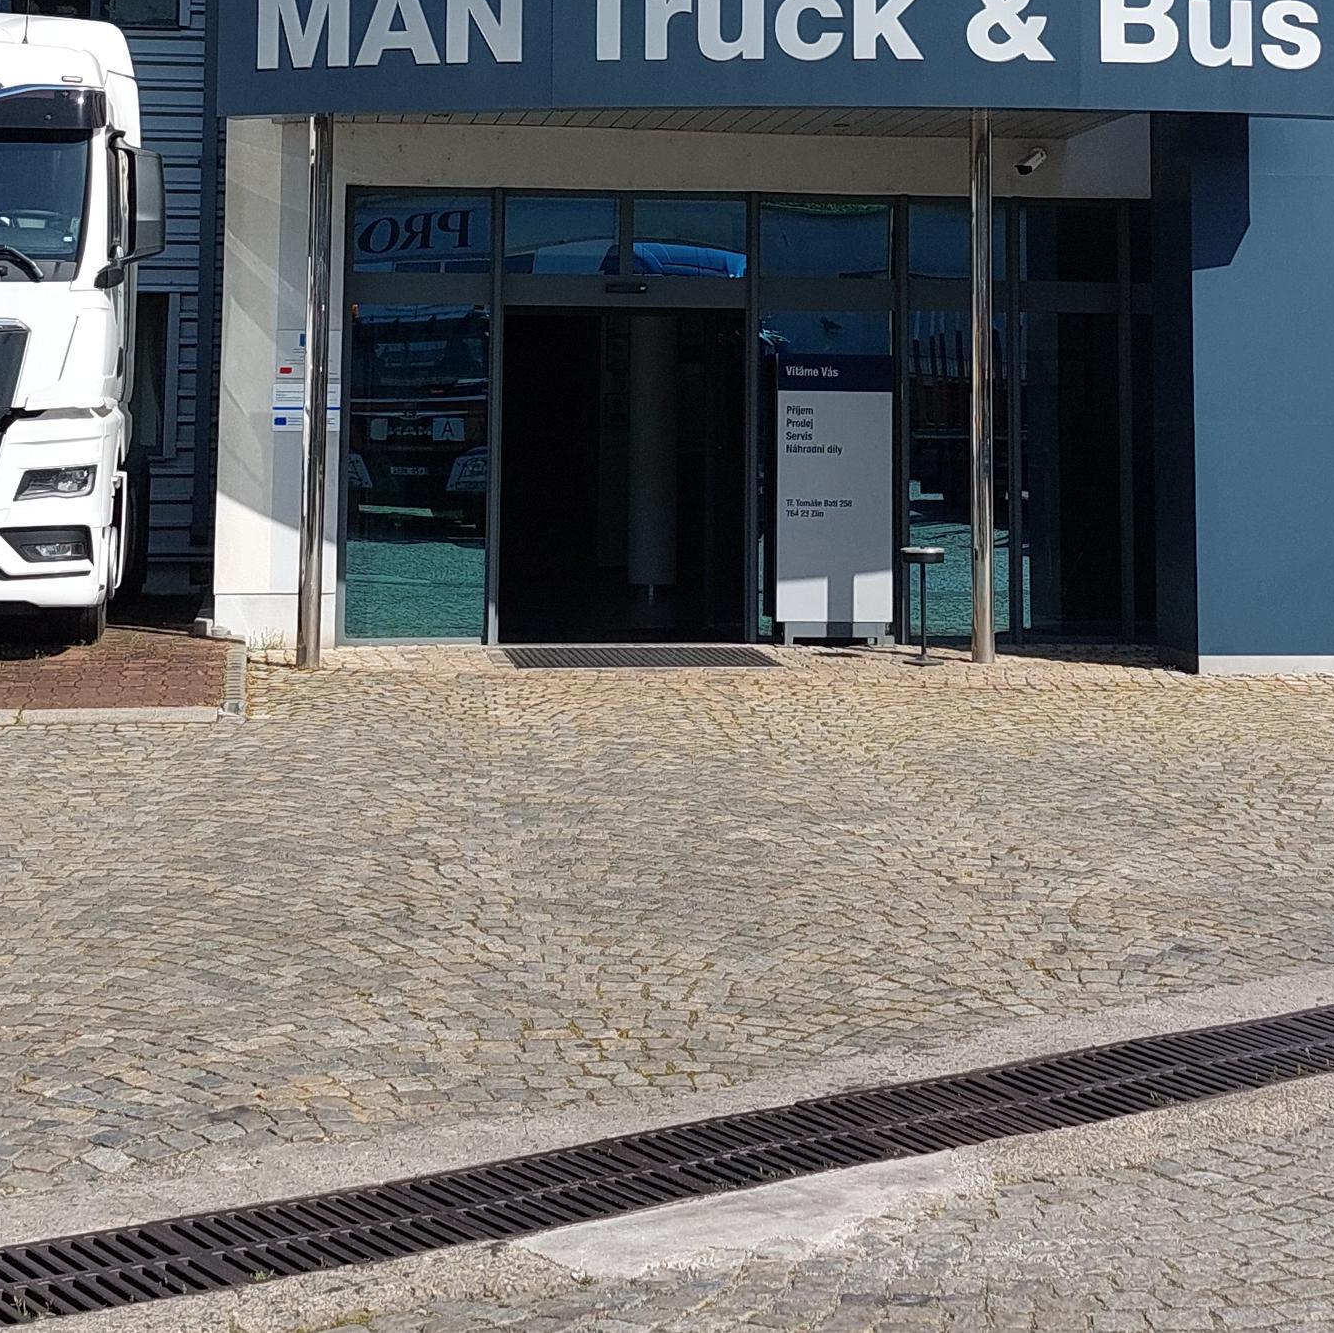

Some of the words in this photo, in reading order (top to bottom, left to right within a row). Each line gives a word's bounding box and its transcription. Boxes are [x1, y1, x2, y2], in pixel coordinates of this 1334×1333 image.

[786, 365, 818, 377] Vítáme
[821, 365, 839, 377] Vás
[786, 405, 814, 417] Příjem
[786, 418, 814, 430] Prodej
[786, 431, 813, 441] Servis
[786, 444, 825, 454] Náhradní
[827, 443, 843, 456] díly
